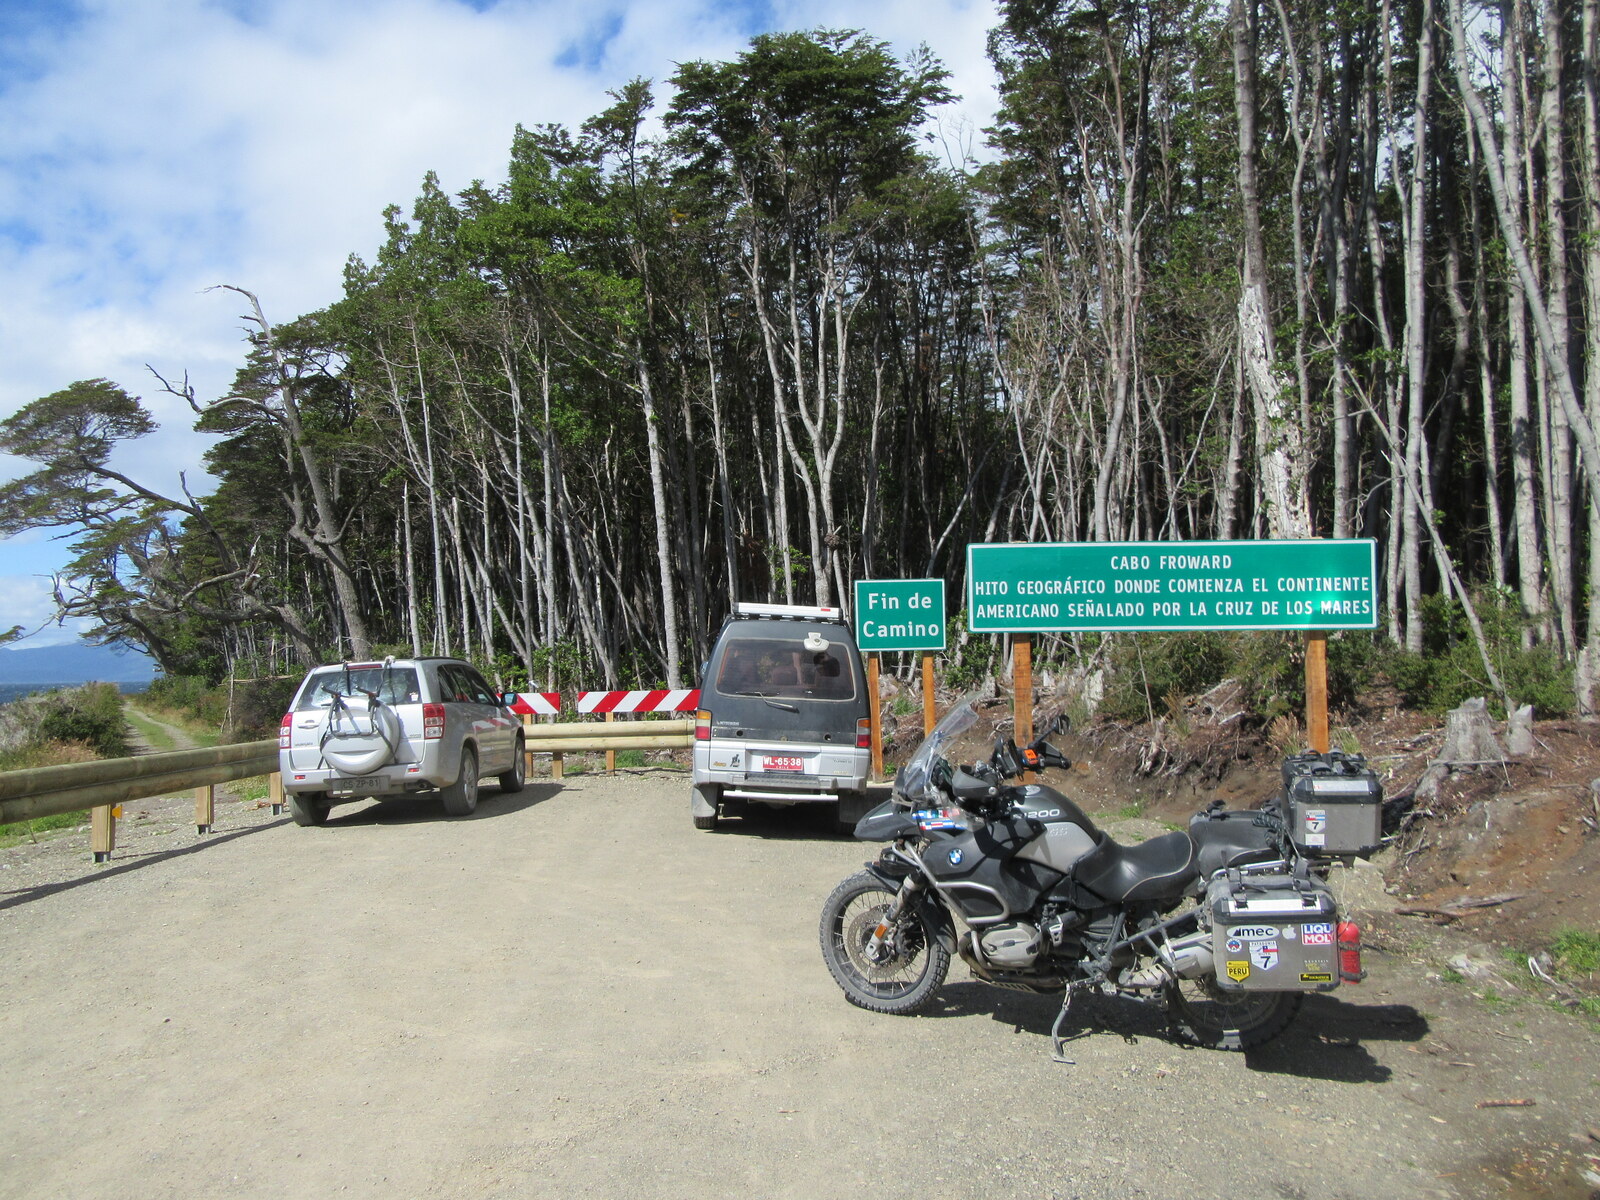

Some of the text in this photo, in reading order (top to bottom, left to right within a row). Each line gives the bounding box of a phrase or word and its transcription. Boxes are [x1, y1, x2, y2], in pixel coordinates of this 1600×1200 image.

[1111, 555, 1232, 570] CABO FROWARD
[975, 576, 1369, 595] HITO GEOGRÁFICO DONDE COMIENZA EL CONTINENTE
[868, 592, 932, 610] Fin de
[976, 599, 1370, 618] AMERICANO SEÑALADO POR LA CRUZ DE LOS MARES
[863, 620, 939, 638] Camino
[1311, 821, 1320, 830] 7
[1242, 928, 1274, 936] mec
[1304, 934, 1335, 943] MOLY
[1260, 956, 1271, 968] 7
[1228, 967, 1247, 975] PERU
